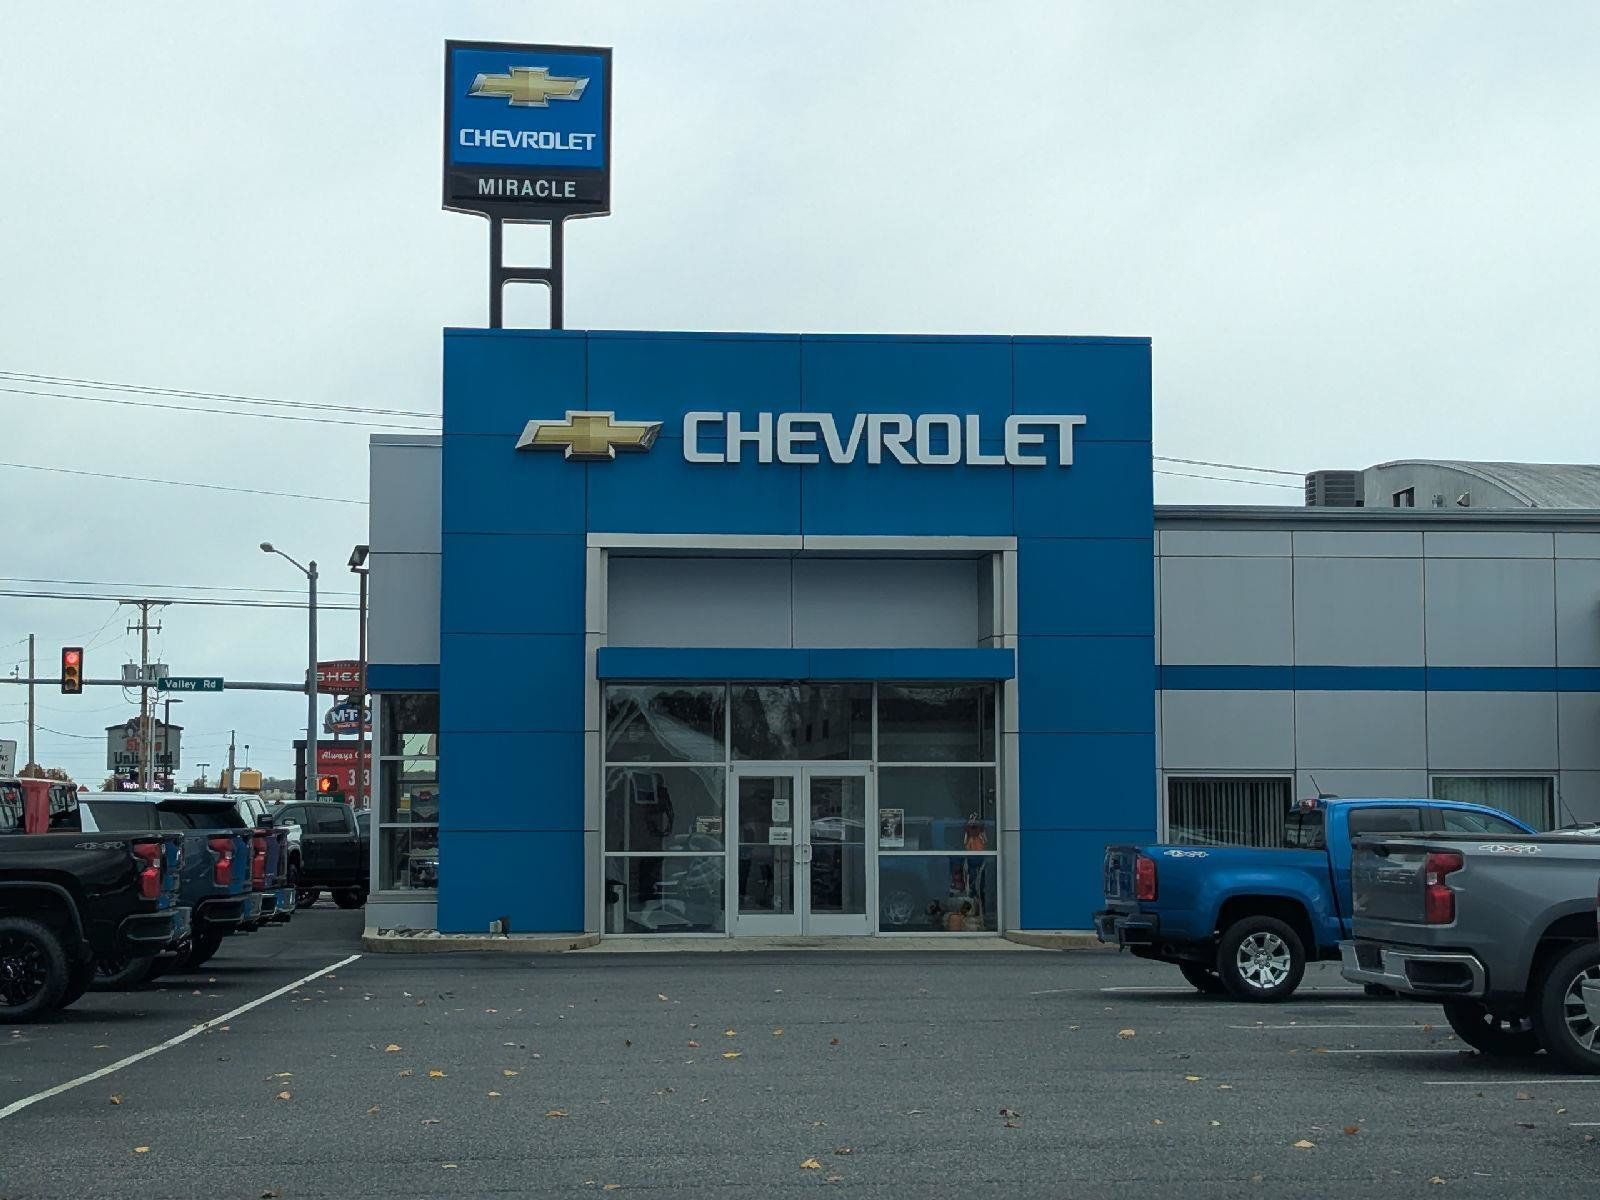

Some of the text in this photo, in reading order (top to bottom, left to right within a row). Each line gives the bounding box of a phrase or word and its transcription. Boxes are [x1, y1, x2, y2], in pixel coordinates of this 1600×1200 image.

[460, 128, 597, 151] CHEVROLET
[478, 178, 577, 198] MIRACLE
[683, 411, 1088, 466] CHEVROLET
[165, 679, 217, 690] Valley Rd
[113, 751, 173, 765] Unlited
